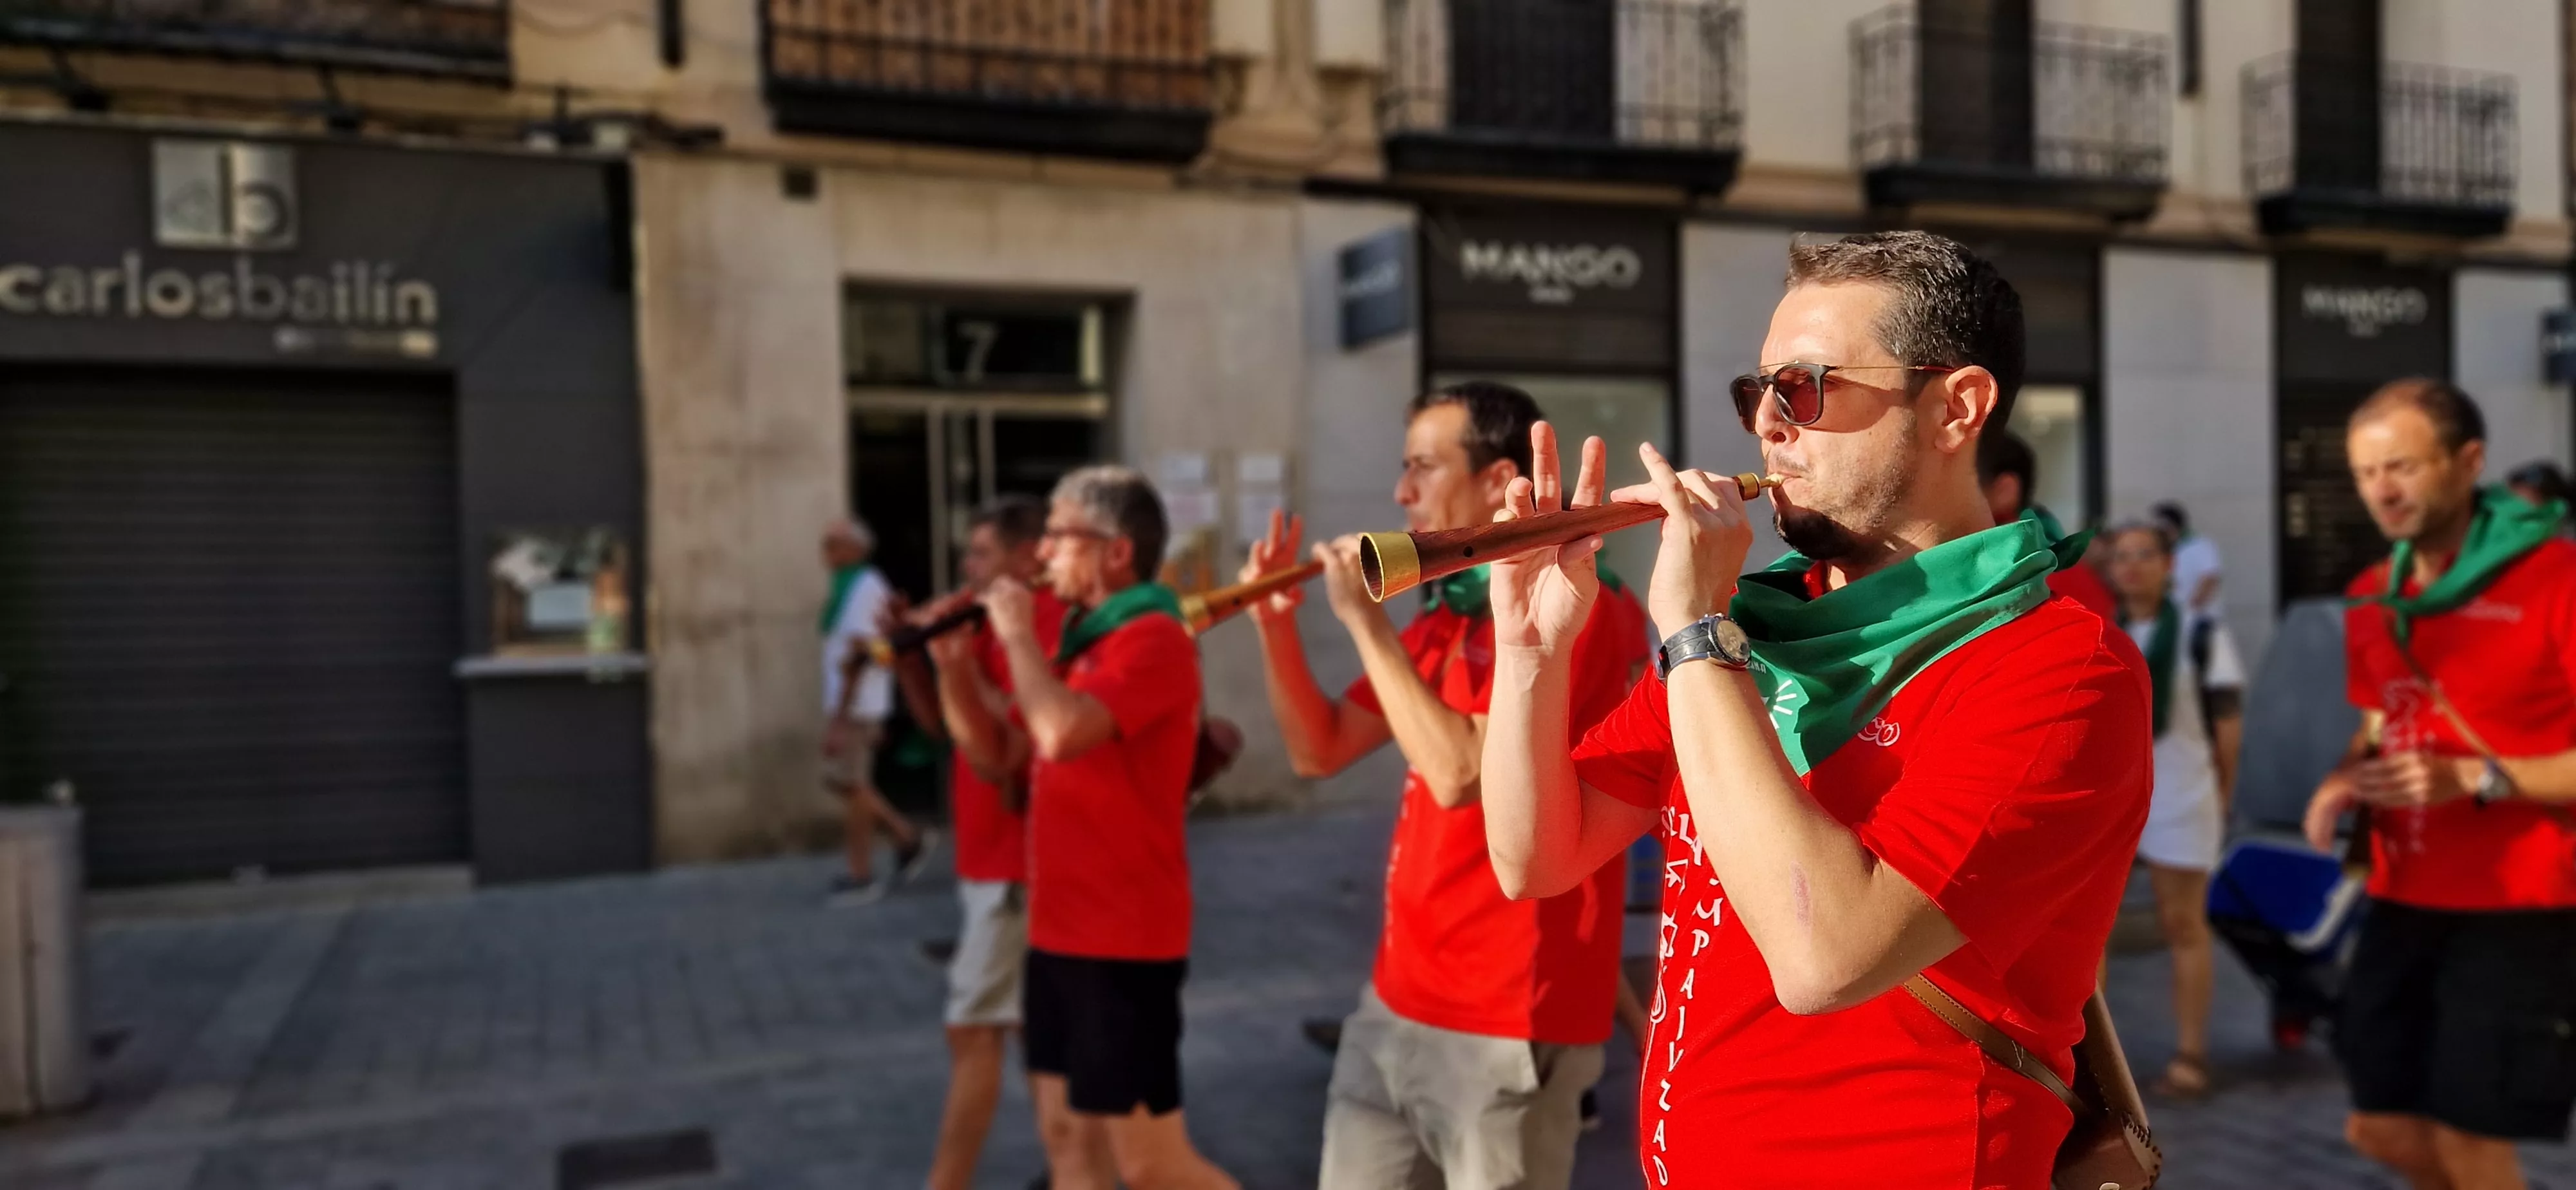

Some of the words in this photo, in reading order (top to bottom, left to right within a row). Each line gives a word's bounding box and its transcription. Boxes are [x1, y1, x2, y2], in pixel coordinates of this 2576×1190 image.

[0, 253, 438, 324] carlosbailín
[1461, 240, 1641, 288] MANGO
[957, 321, 999, 383] 7
